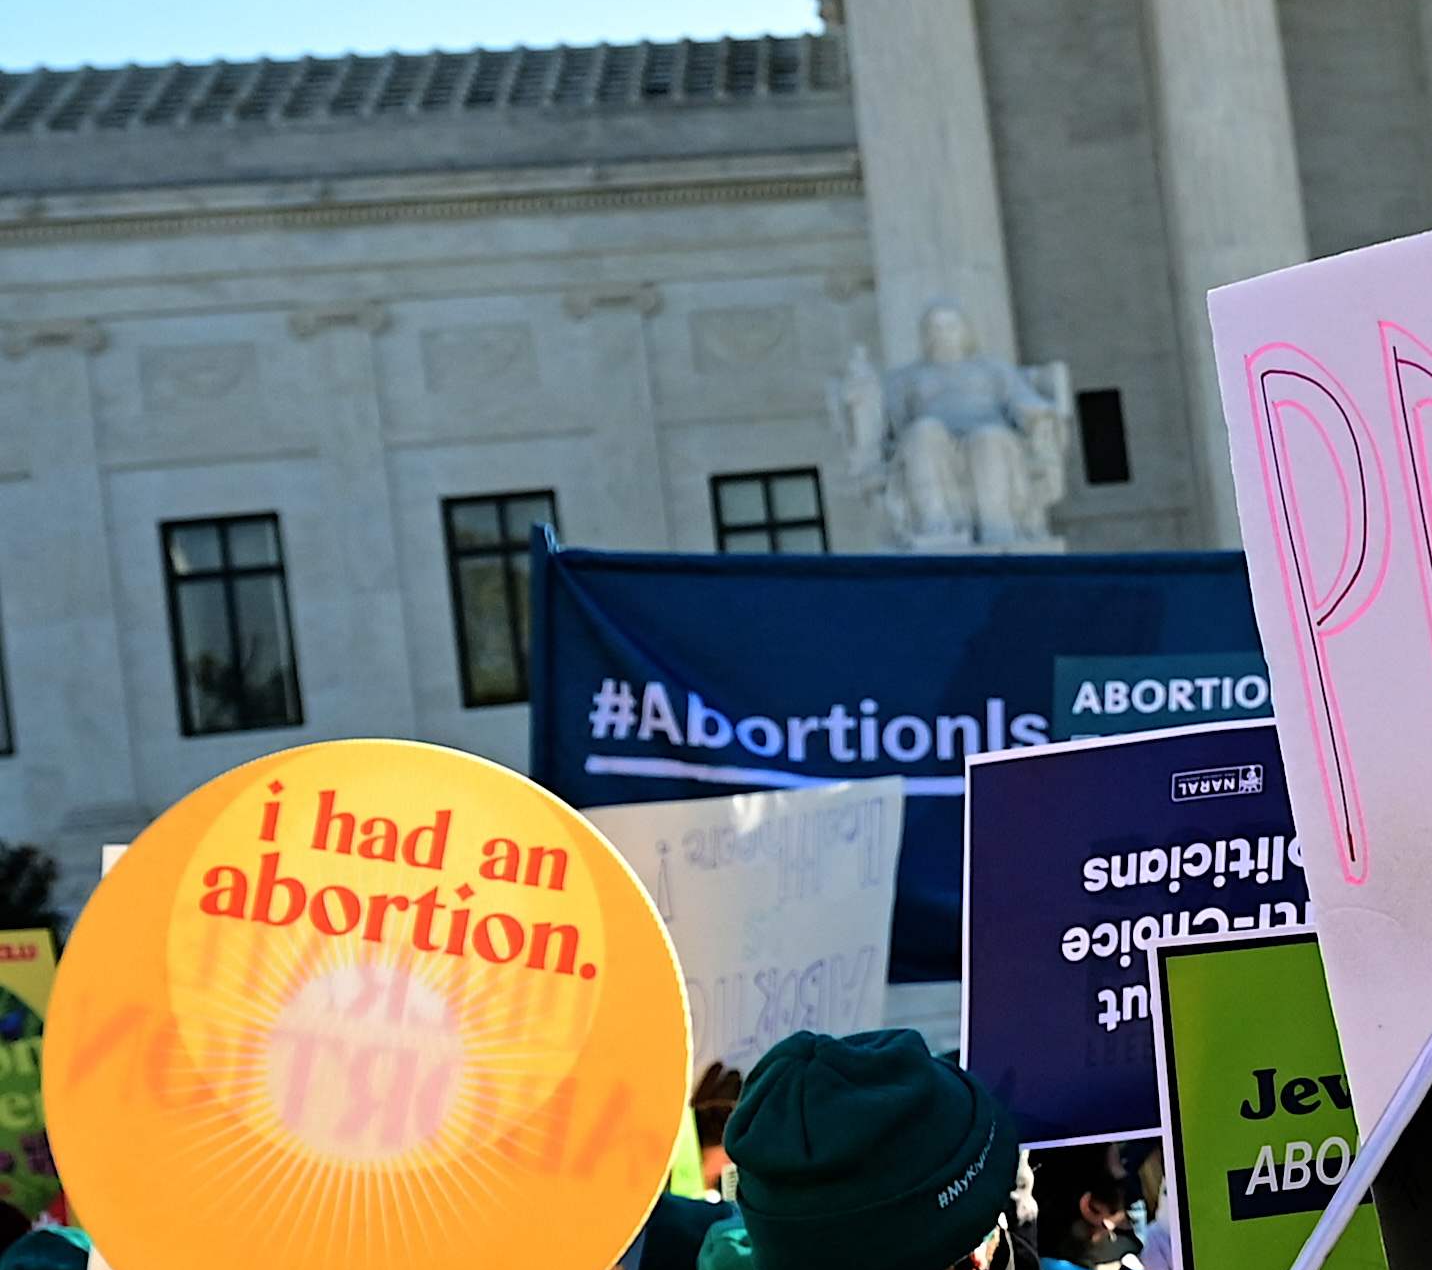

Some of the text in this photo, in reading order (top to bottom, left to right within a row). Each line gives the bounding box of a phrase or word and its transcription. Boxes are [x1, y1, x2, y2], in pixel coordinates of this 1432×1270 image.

[588, 678, 1050, 762] #AbortionIs
[1072, 675, 1269, 715] ABORTIO
[1178, 778, 1235, 795] NARAL
[259, 780, 570, 891] i had an
[1083, 835, 1304, 893] oliticians
[200, 851, 597, 979] abortion.
[1098, 985, 1148, 1031] ut
